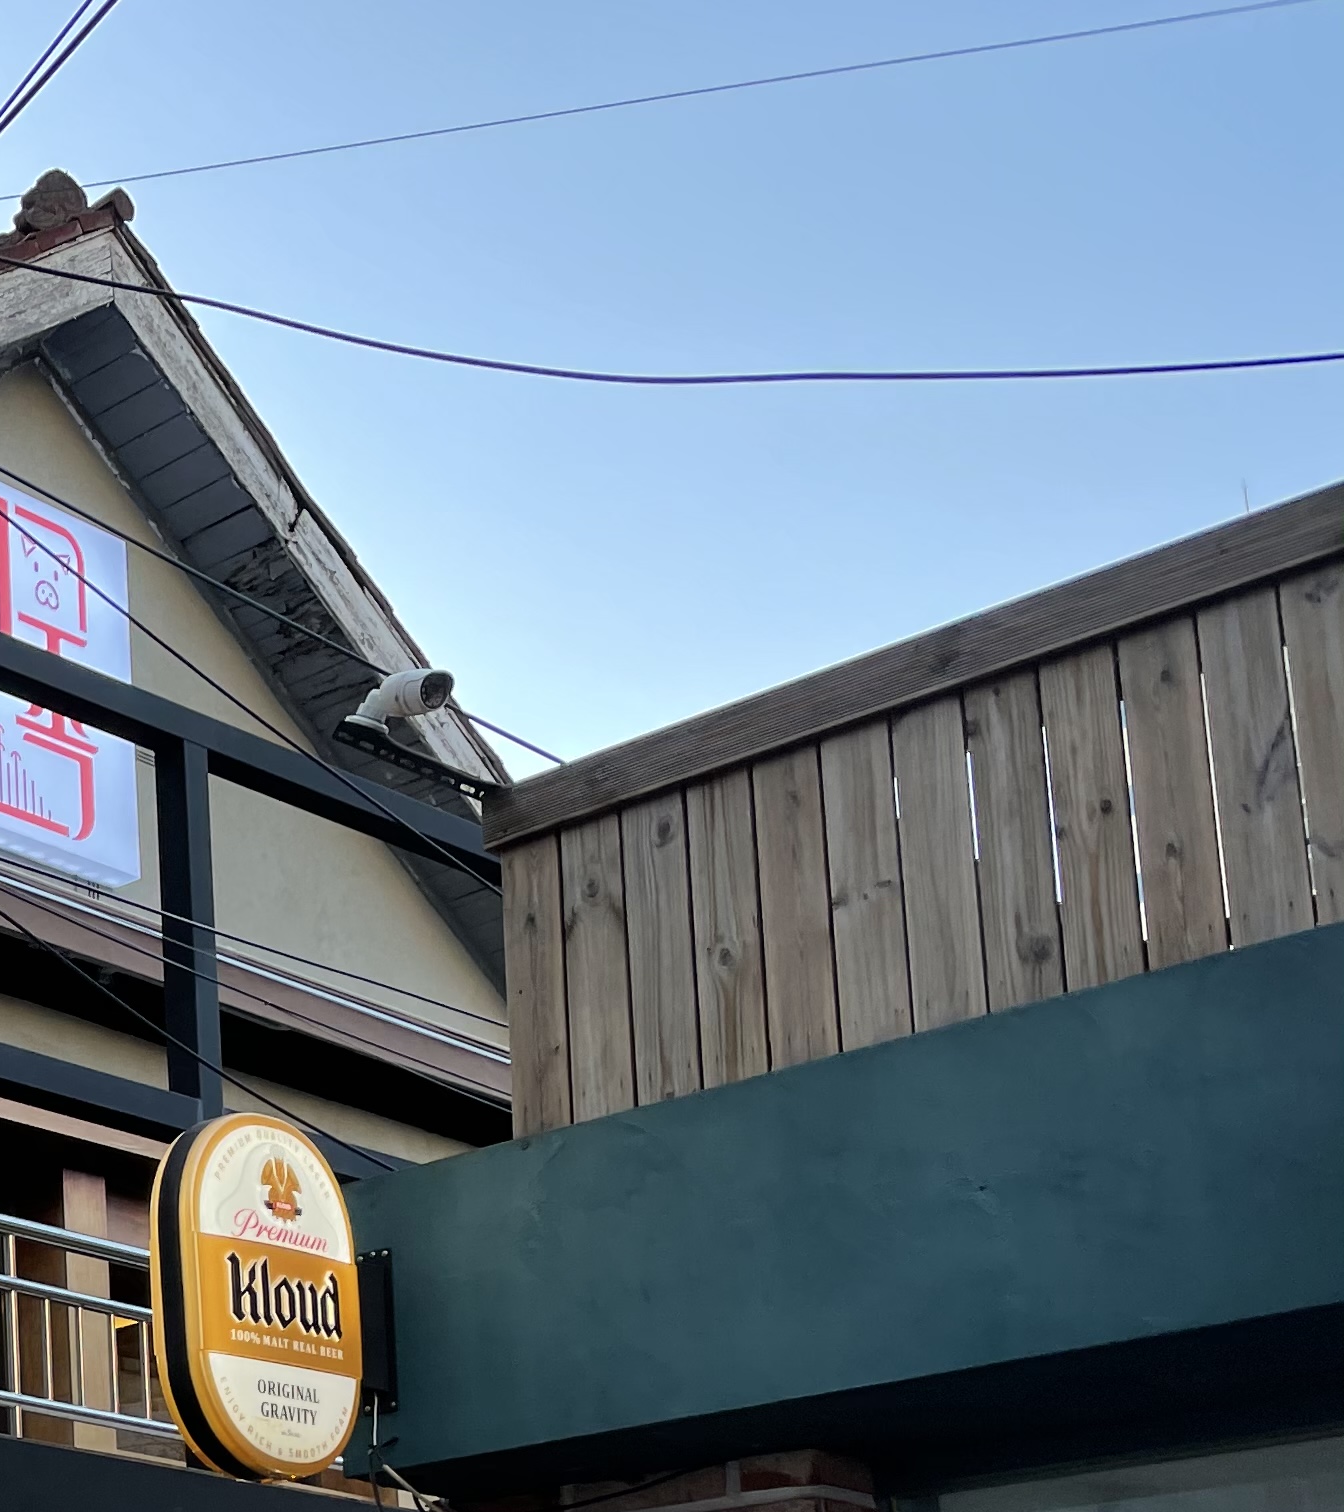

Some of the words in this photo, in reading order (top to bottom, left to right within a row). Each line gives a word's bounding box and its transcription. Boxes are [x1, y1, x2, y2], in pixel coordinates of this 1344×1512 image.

[231, 1207, 329, 1254] Premium
[230, 1328, 261, 1345] 100%
[262, 1335, 290, 1350] MALT
[292, 1341, 317, 1356] REAL
[319, 1346, 344, 1361] BEER
[257, 1378, 321, 1405] ORIGINAL
[260, 1401, 318, 1427] GRAVITY
